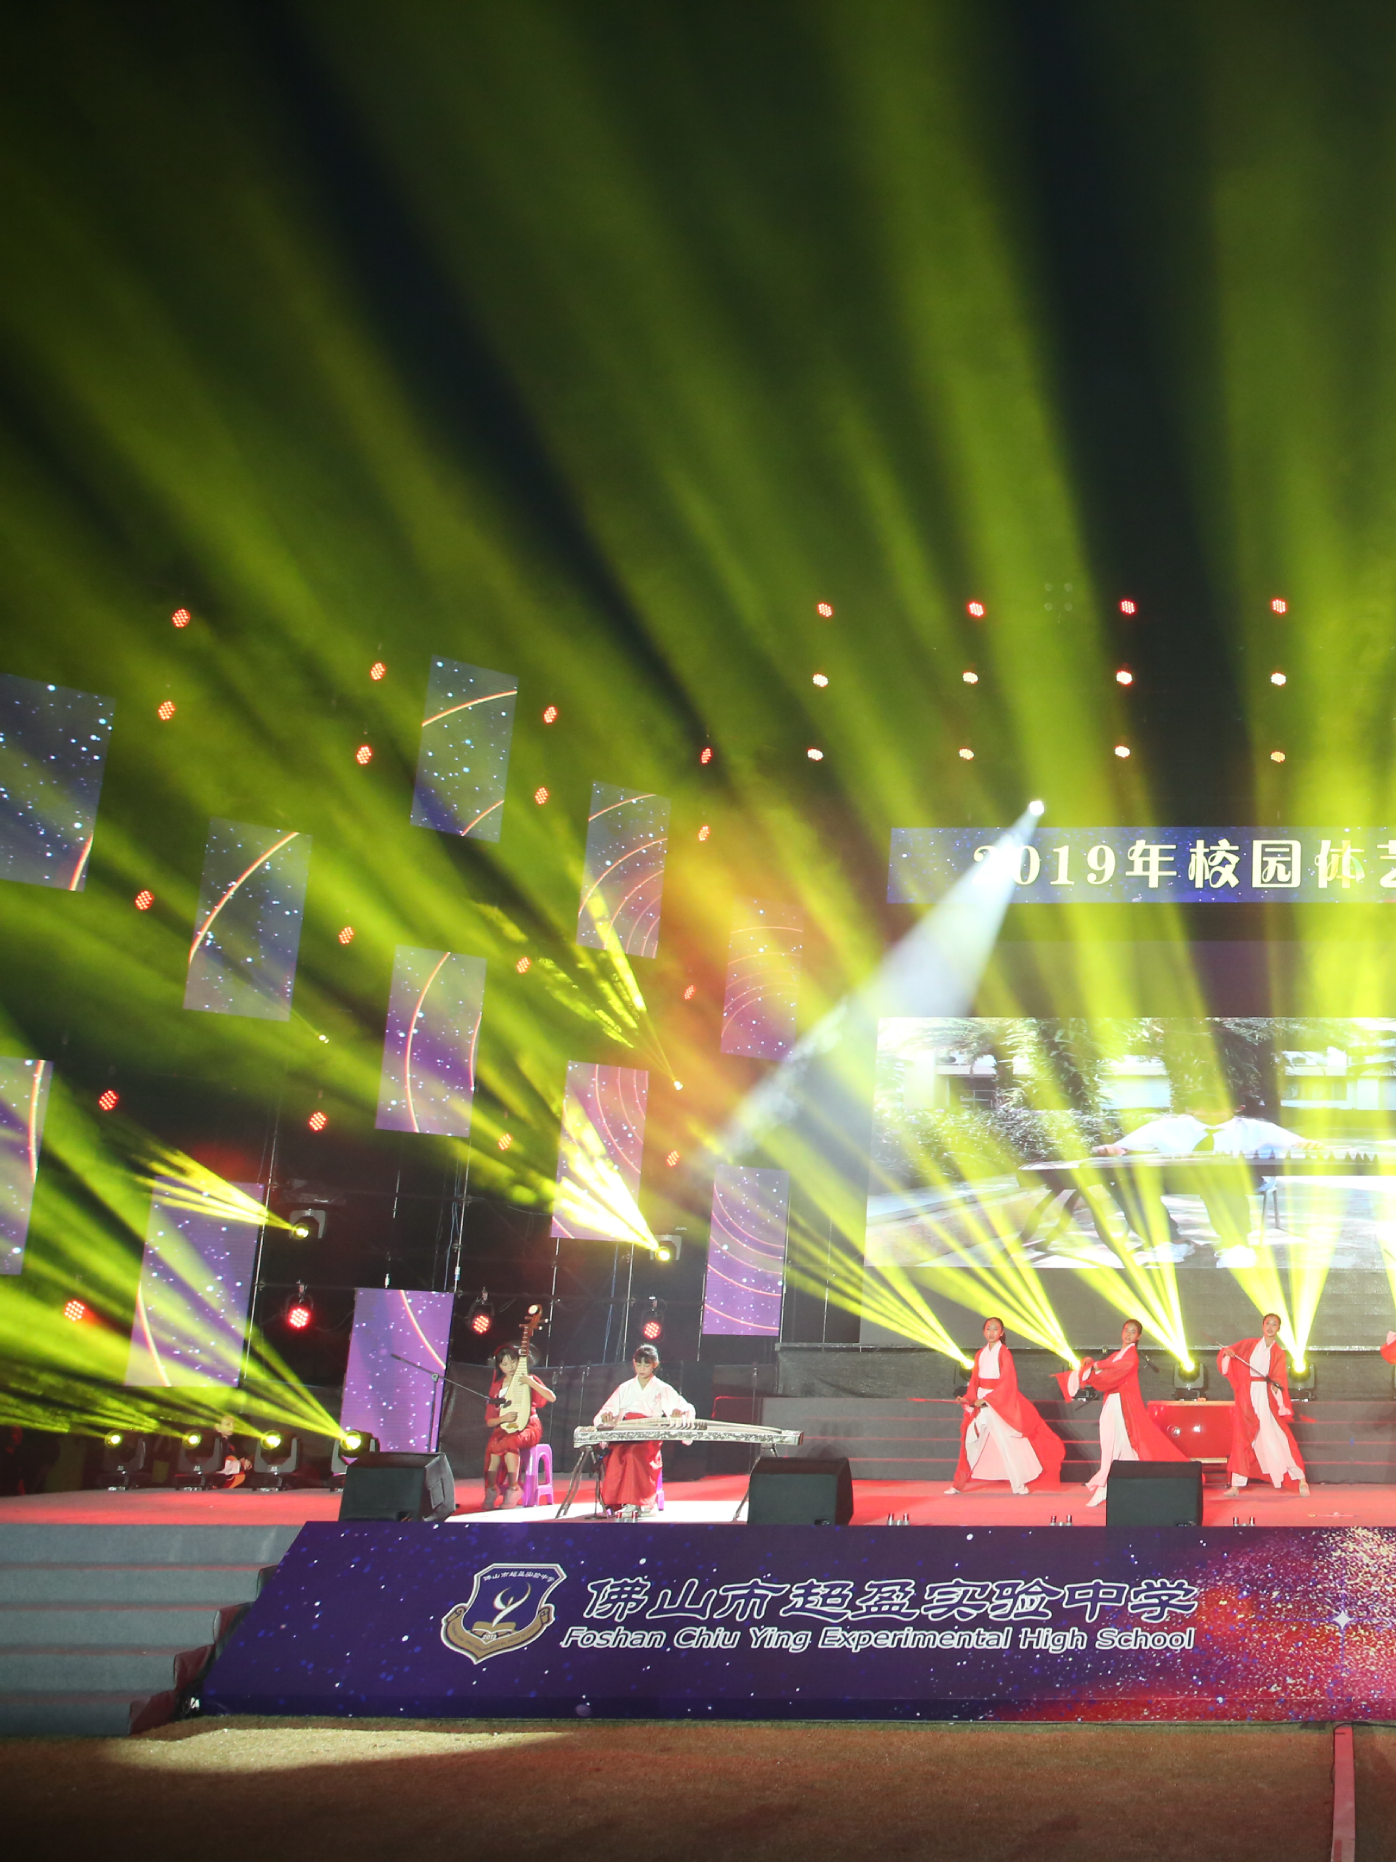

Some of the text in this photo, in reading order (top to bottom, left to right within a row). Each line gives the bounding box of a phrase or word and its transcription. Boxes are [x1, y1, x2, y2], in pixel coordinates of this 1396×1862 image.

[582, 1578, 1199, 1623] 佛山市超盈实验中学
[561, 1625, 666, 1649] Foshan
[673, 1625, 741, 1649] Chiu
[749, 1626, 813, 1653] Ying
[817, 1626, 1013, 1653] Experimental
[1019, 1626, 1089, 1654] High
[1095, 1626, 1198, 1650] School
